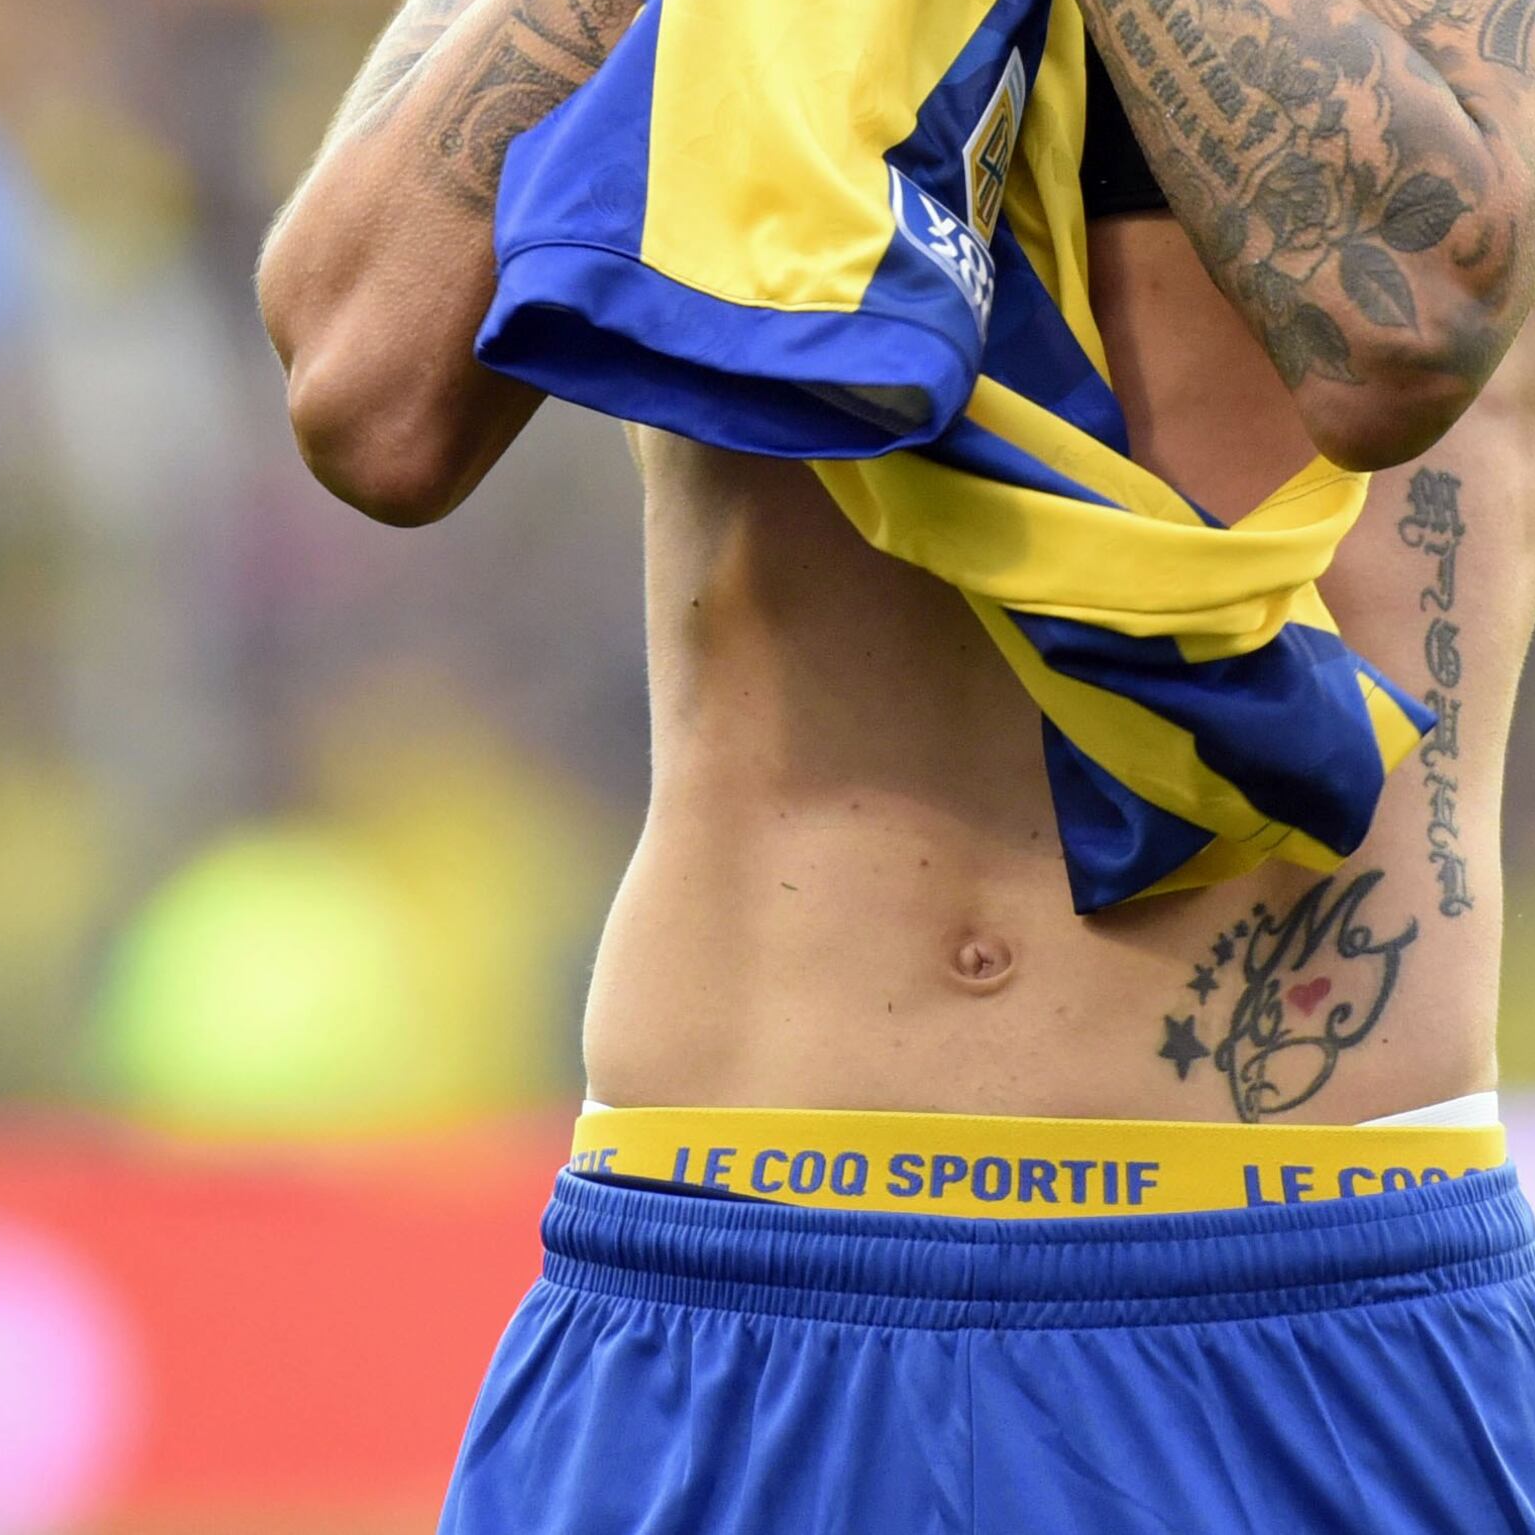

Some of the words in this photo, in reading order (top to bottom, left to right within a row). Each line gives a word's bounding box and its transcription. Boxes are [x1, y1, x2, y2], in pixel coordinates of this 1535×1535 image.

[671, 1147, 736, 1192] LE
[750, 1149, 868, 1196] COQ
[888, 1154, 1160, 1205] SPORTIF
[1244, 1164, 1314, 1208] LE
